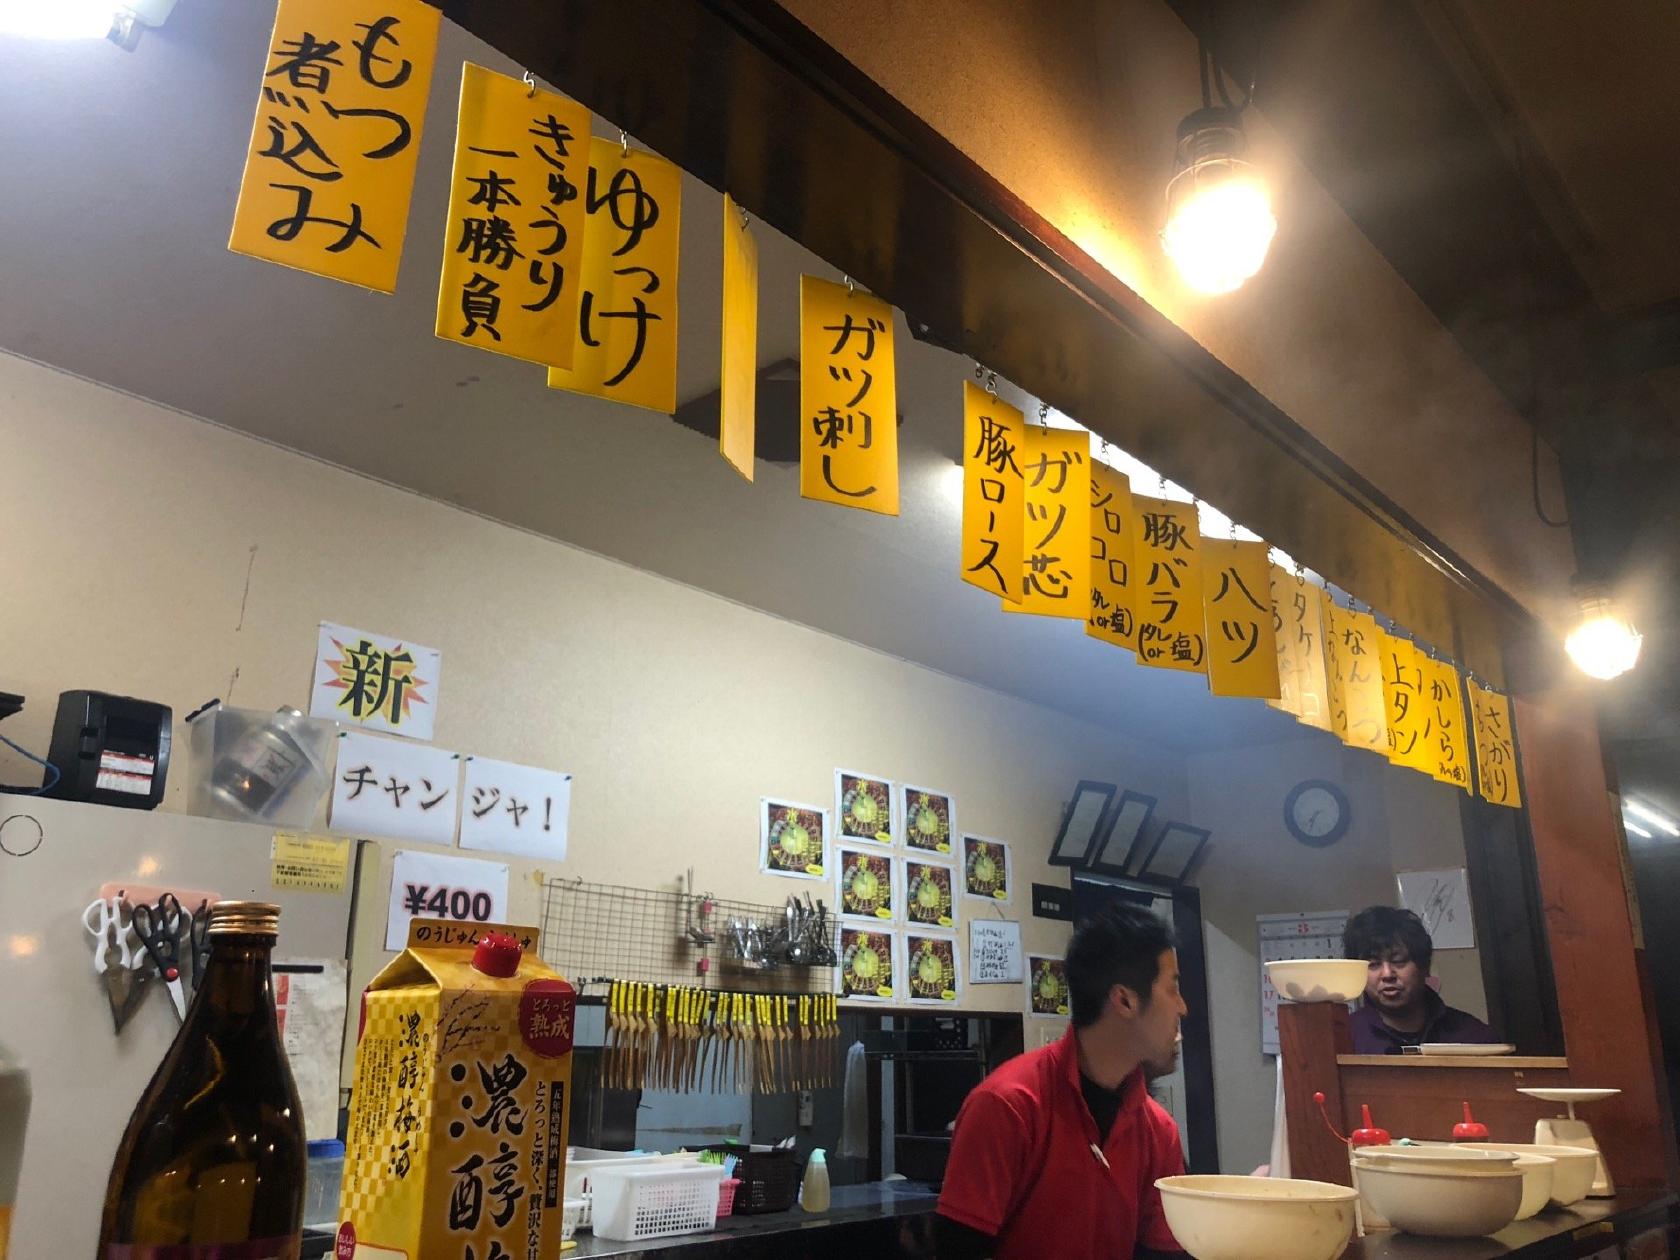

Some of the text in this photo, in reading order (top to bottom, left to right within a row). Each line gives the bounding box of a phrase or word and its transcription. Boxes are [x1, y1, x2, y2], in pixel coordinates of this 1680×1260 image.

[257, 32, 383, 253] 煮込み
[321, 16, 412, 159] もつ
[456, 145, 526, 342] 一本勝負
[521, 114, 578, 312] きゅうり
[579, 167, 663, 387] ゆっけ
[812, 314, 886, 497] ガツ刺し
[966, 415, 1024, 594] 豚ロース
[1022, 450, 1082, 599] ガツ芯
[1141, 511, 1195, 624] 豚バラ
[1212, 567, 1268, 664] ハツ
[338, 639, 414, 724] 新
[1431, 679, 1454, 762] かしら
[343, 764, 451, 811] チャン
[1484, 706, 1513, 803] さがり
[404, 883, 492, 922] ¥400
[530, 1012, 570, 1040] 熟成
[532, 997, 571, 1012] とろっと
[449, 1053, 528, 1260] 濃醇
